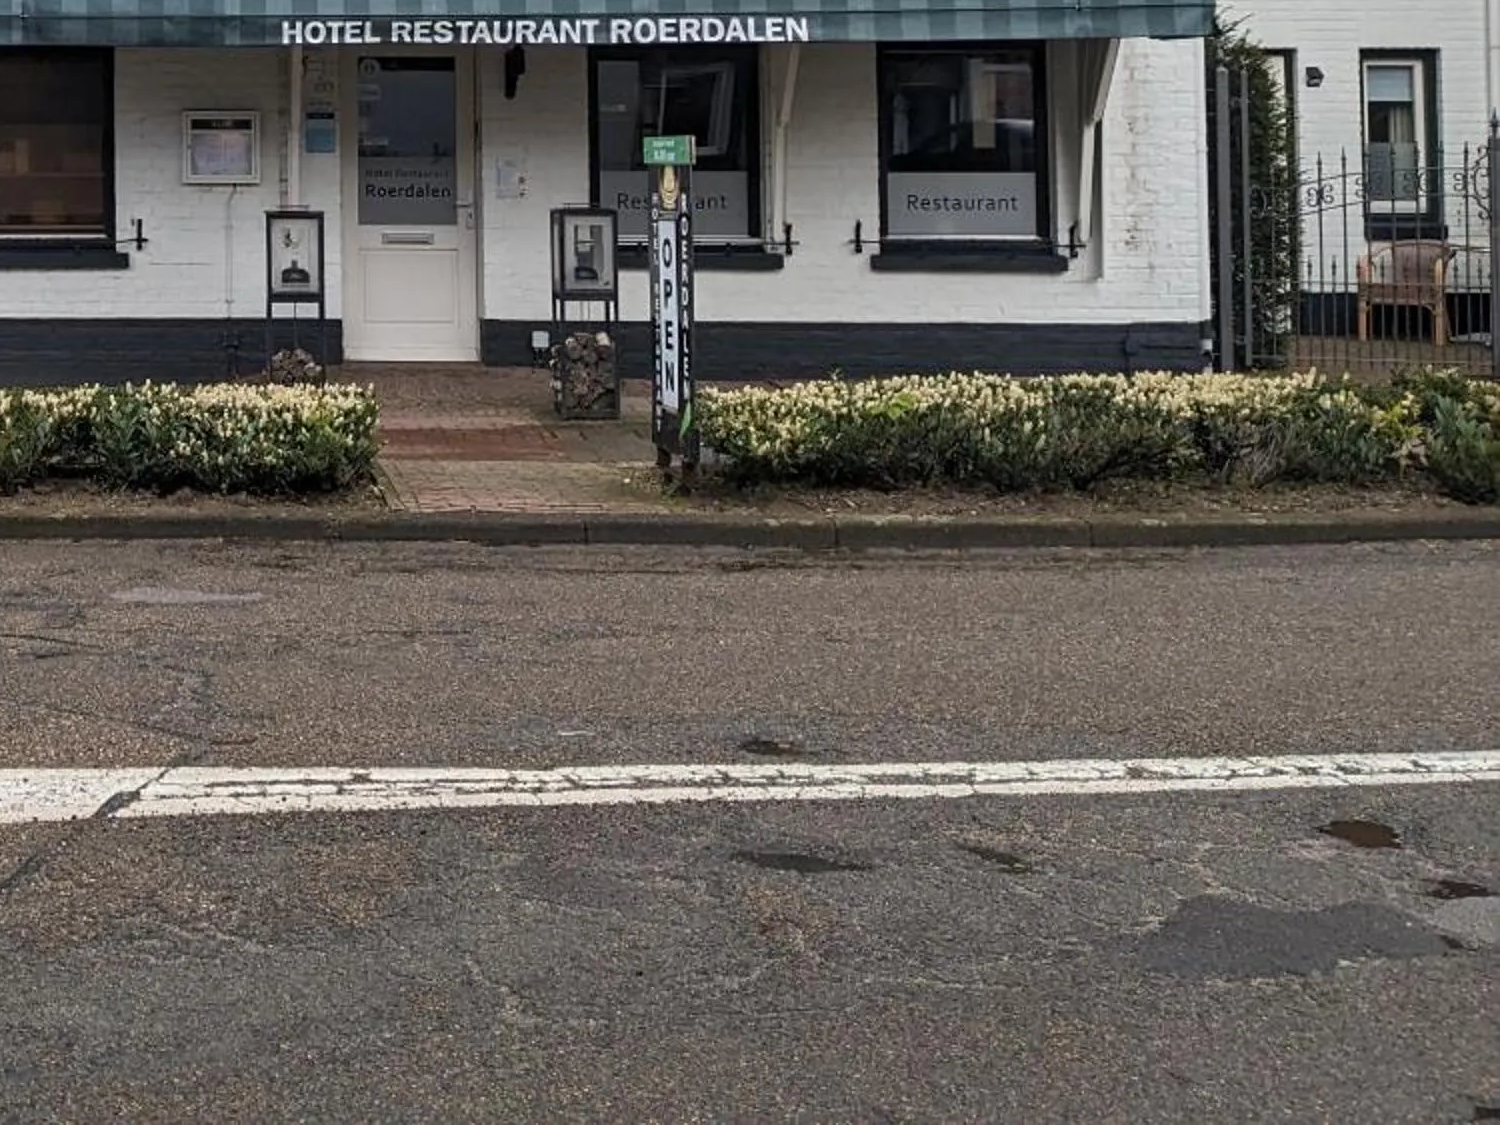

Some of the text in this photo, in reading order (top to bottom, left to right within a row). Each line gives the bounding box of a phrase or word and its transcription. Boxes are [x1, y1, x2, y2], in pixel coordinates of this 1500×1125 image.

[281, 16, 810, 45] HOTEL RESTAURANT ROERDALEN
[365, 183, 452, 199] Roerdalen
[617, 192, 729, 210] Resant
[907, 194, 1019, 211] Restaurant
[662, 237, 676, 393] OPEN
